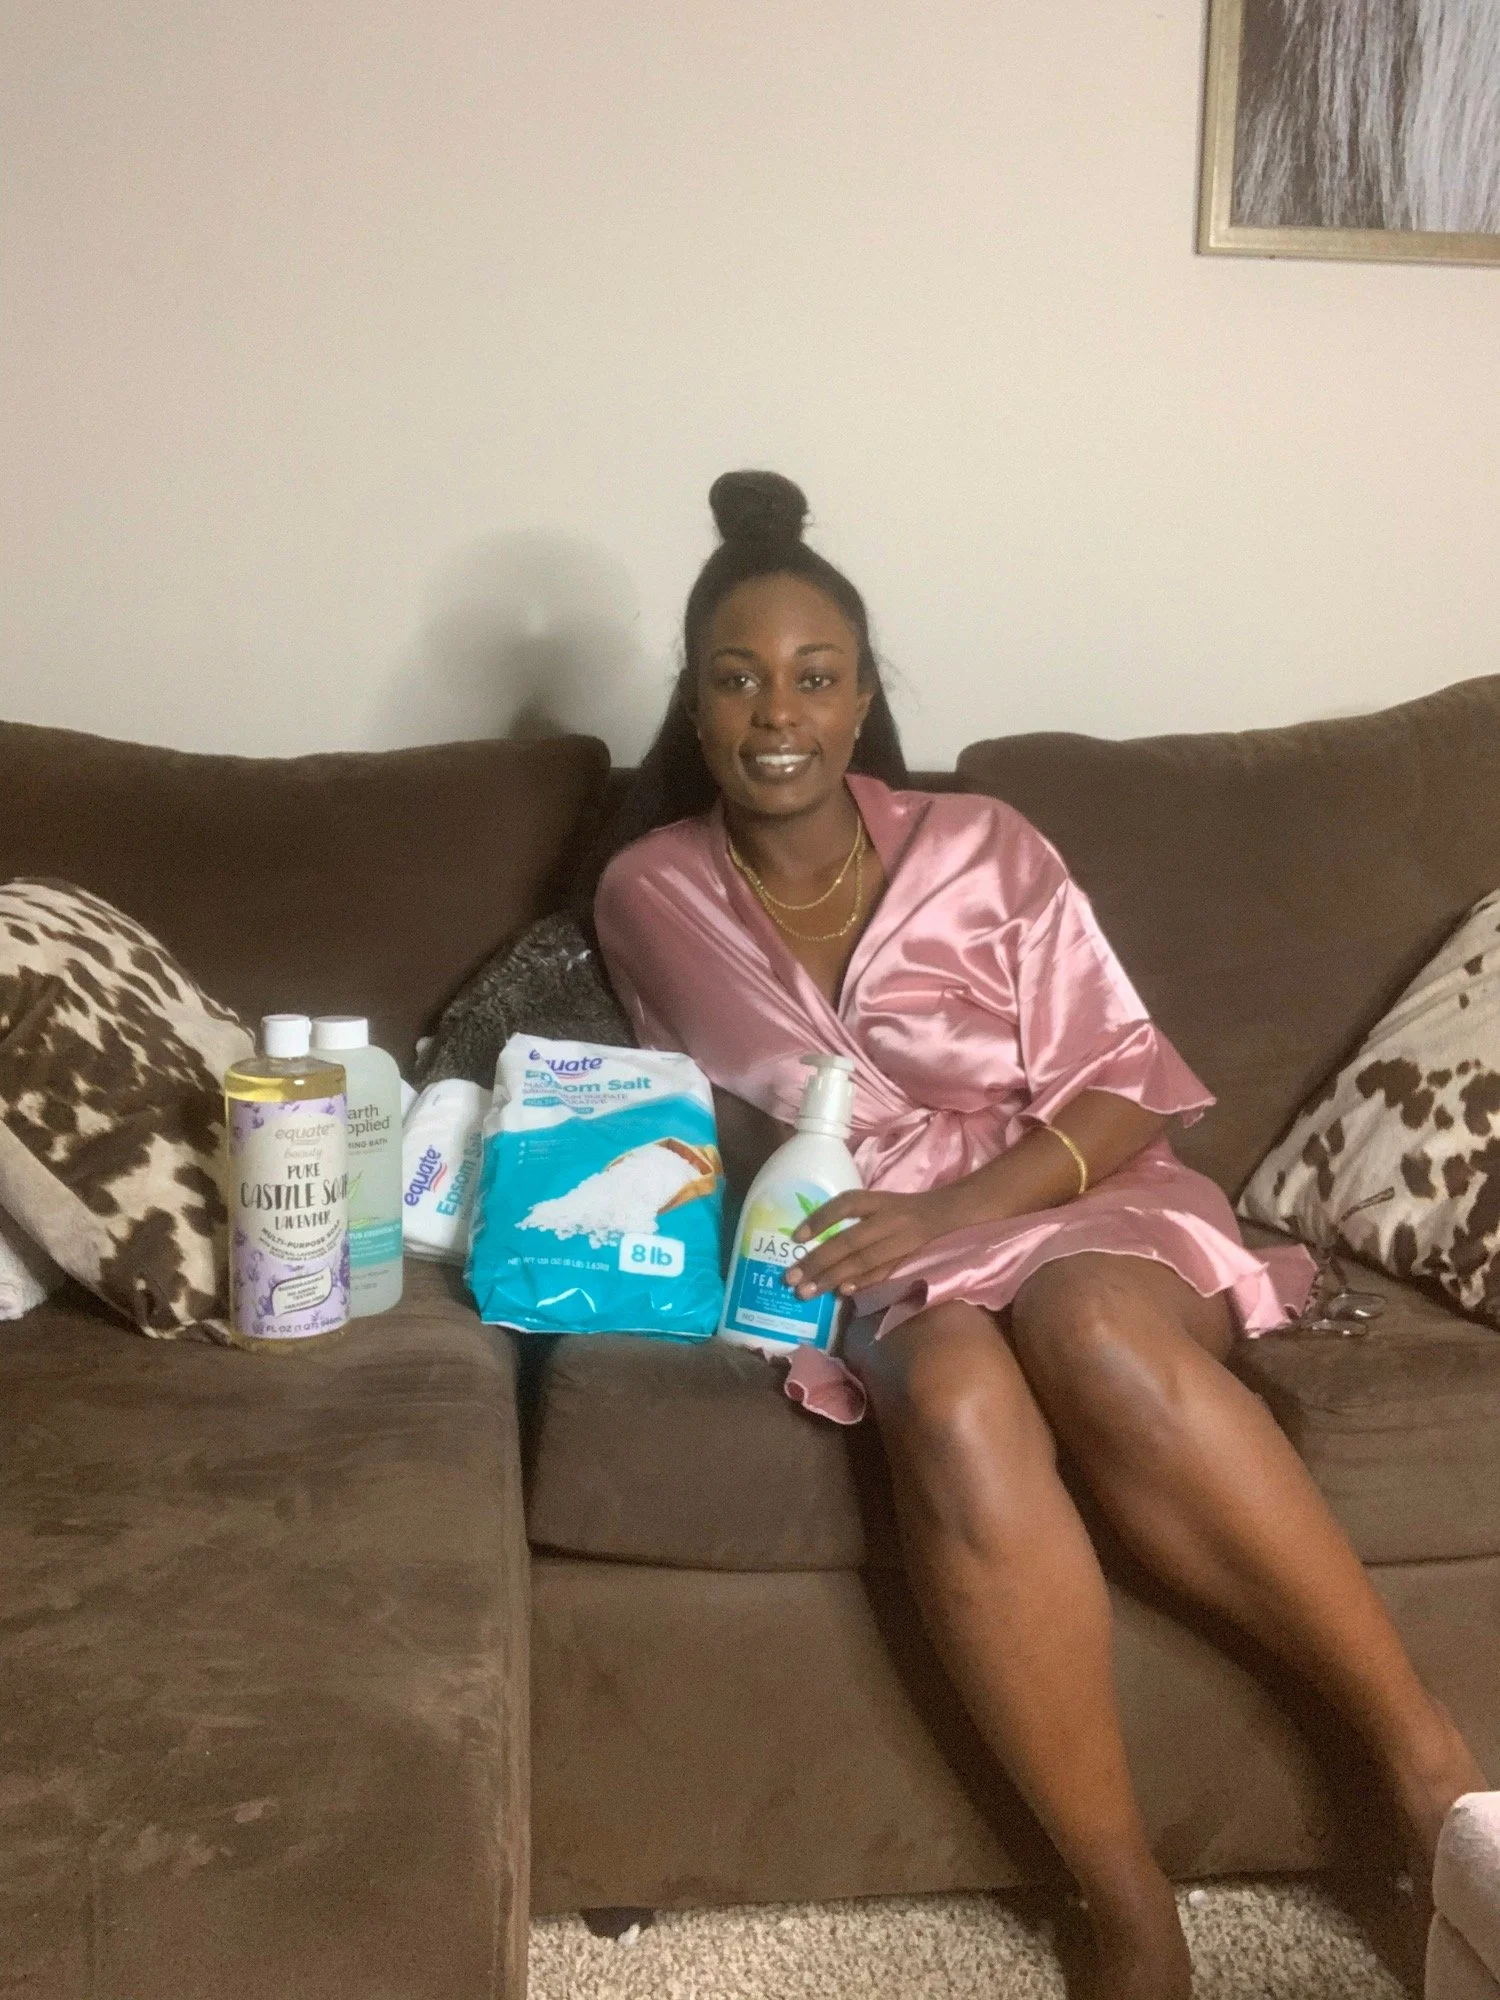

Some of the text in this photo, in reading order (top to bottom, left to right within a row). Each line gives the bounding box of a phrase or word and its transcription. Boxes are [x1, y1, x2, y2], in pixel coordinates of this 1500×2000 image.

[608, 1077, 651, 1091] Salt
[347, 1104, 379, 1119] arth
[275, 1124, 330, 1142] equate
[368, 1137, 388, 1147] BATH
[287, 1163, 320, 1180] PURE
[404, 1144, 442, 1207] equate
[436, 1157, 478, 1216] Epsom
[240, 1182, 316, 1211] CASTILE
[274, 1210, 331, 1230] LAVENDER
[261, 1226, 326, 1249] MULTI-PURPOSE
[326, 1218, 340, 1238] SOAP
[631, 1244, 673, 1266] 8 lb
[752, 1272, 774, 1289] TEA
[742, 1312, 756, 1322] NO
[266, 1324, 277, 1334] FL
[279, 1323, 292, 1333] OZ
